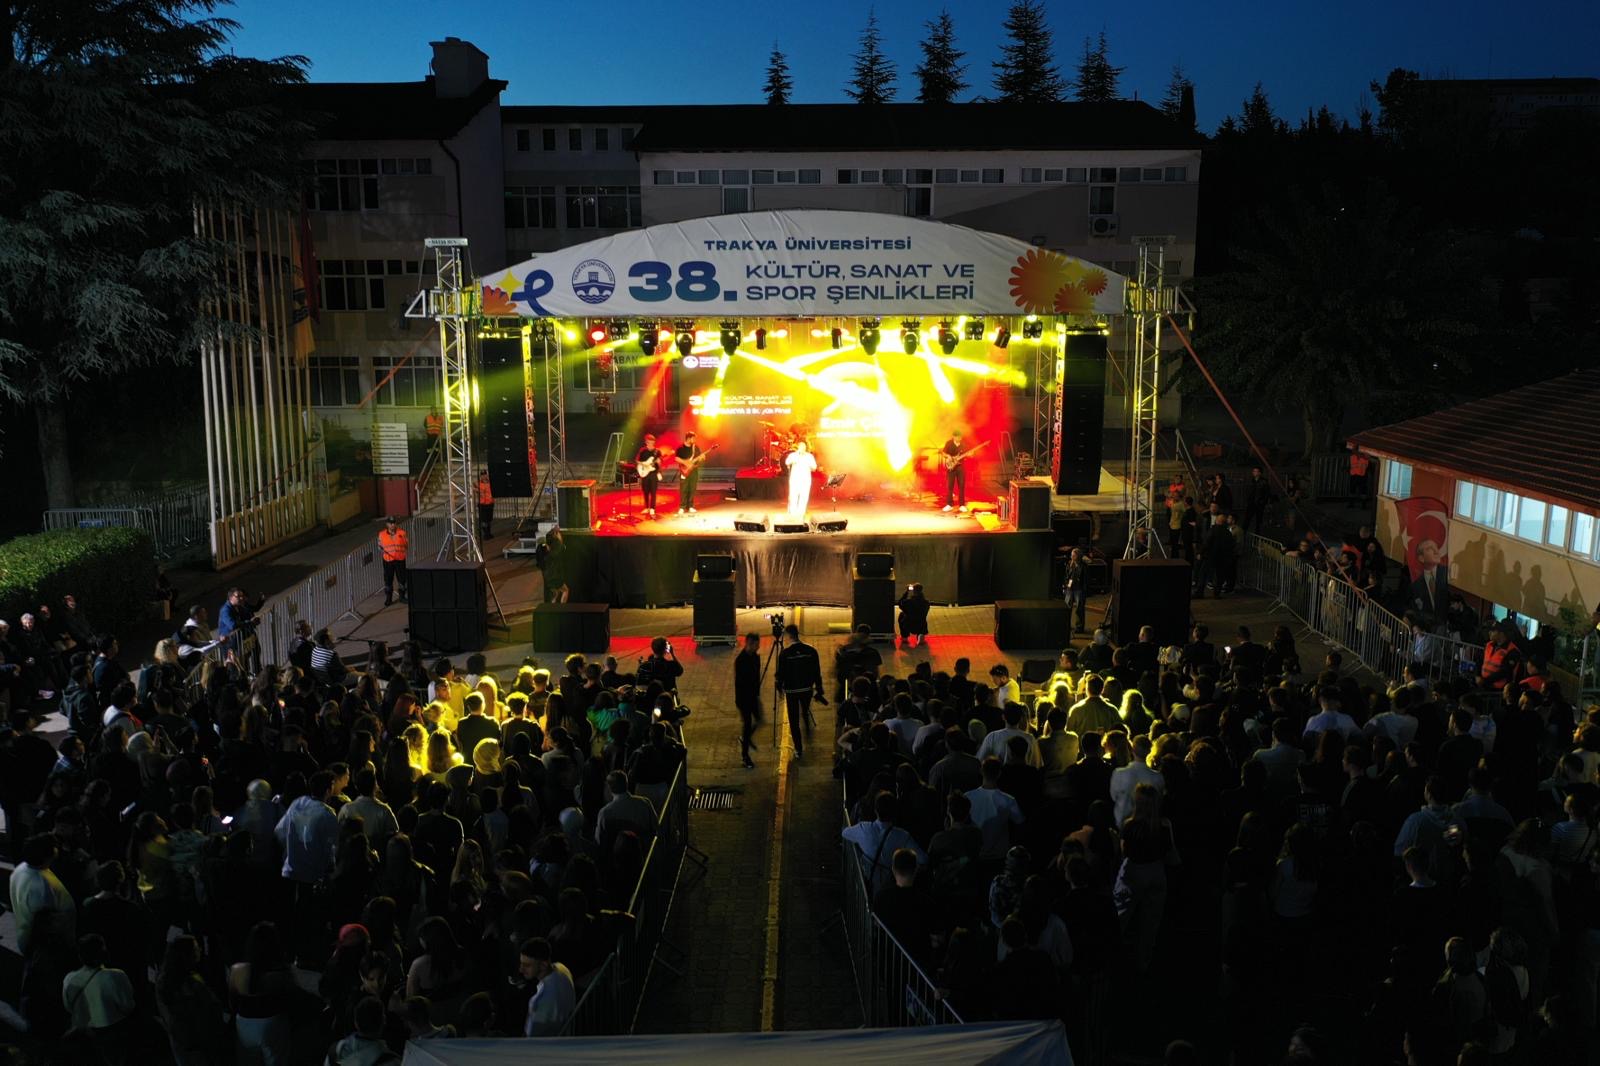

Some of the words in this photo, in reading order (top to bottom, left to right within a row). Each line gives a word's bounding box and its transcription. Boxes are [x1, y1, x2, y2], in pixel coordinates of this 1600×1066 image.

[704, 240, 777, 250] TRAKYA
[784, 236, 911, 250] ÜNİVERSİTESİ
[746, 260, 846, 280] KÜLTÜR,
[850, 264, 932, 279] SANAT
[942, 264, 974, 279] VE
[628, 261, 737, 302] 38.
[746, 285, 816, 301] SPOR
[826, 280, 974, 304] ŞENLİKLERİ
